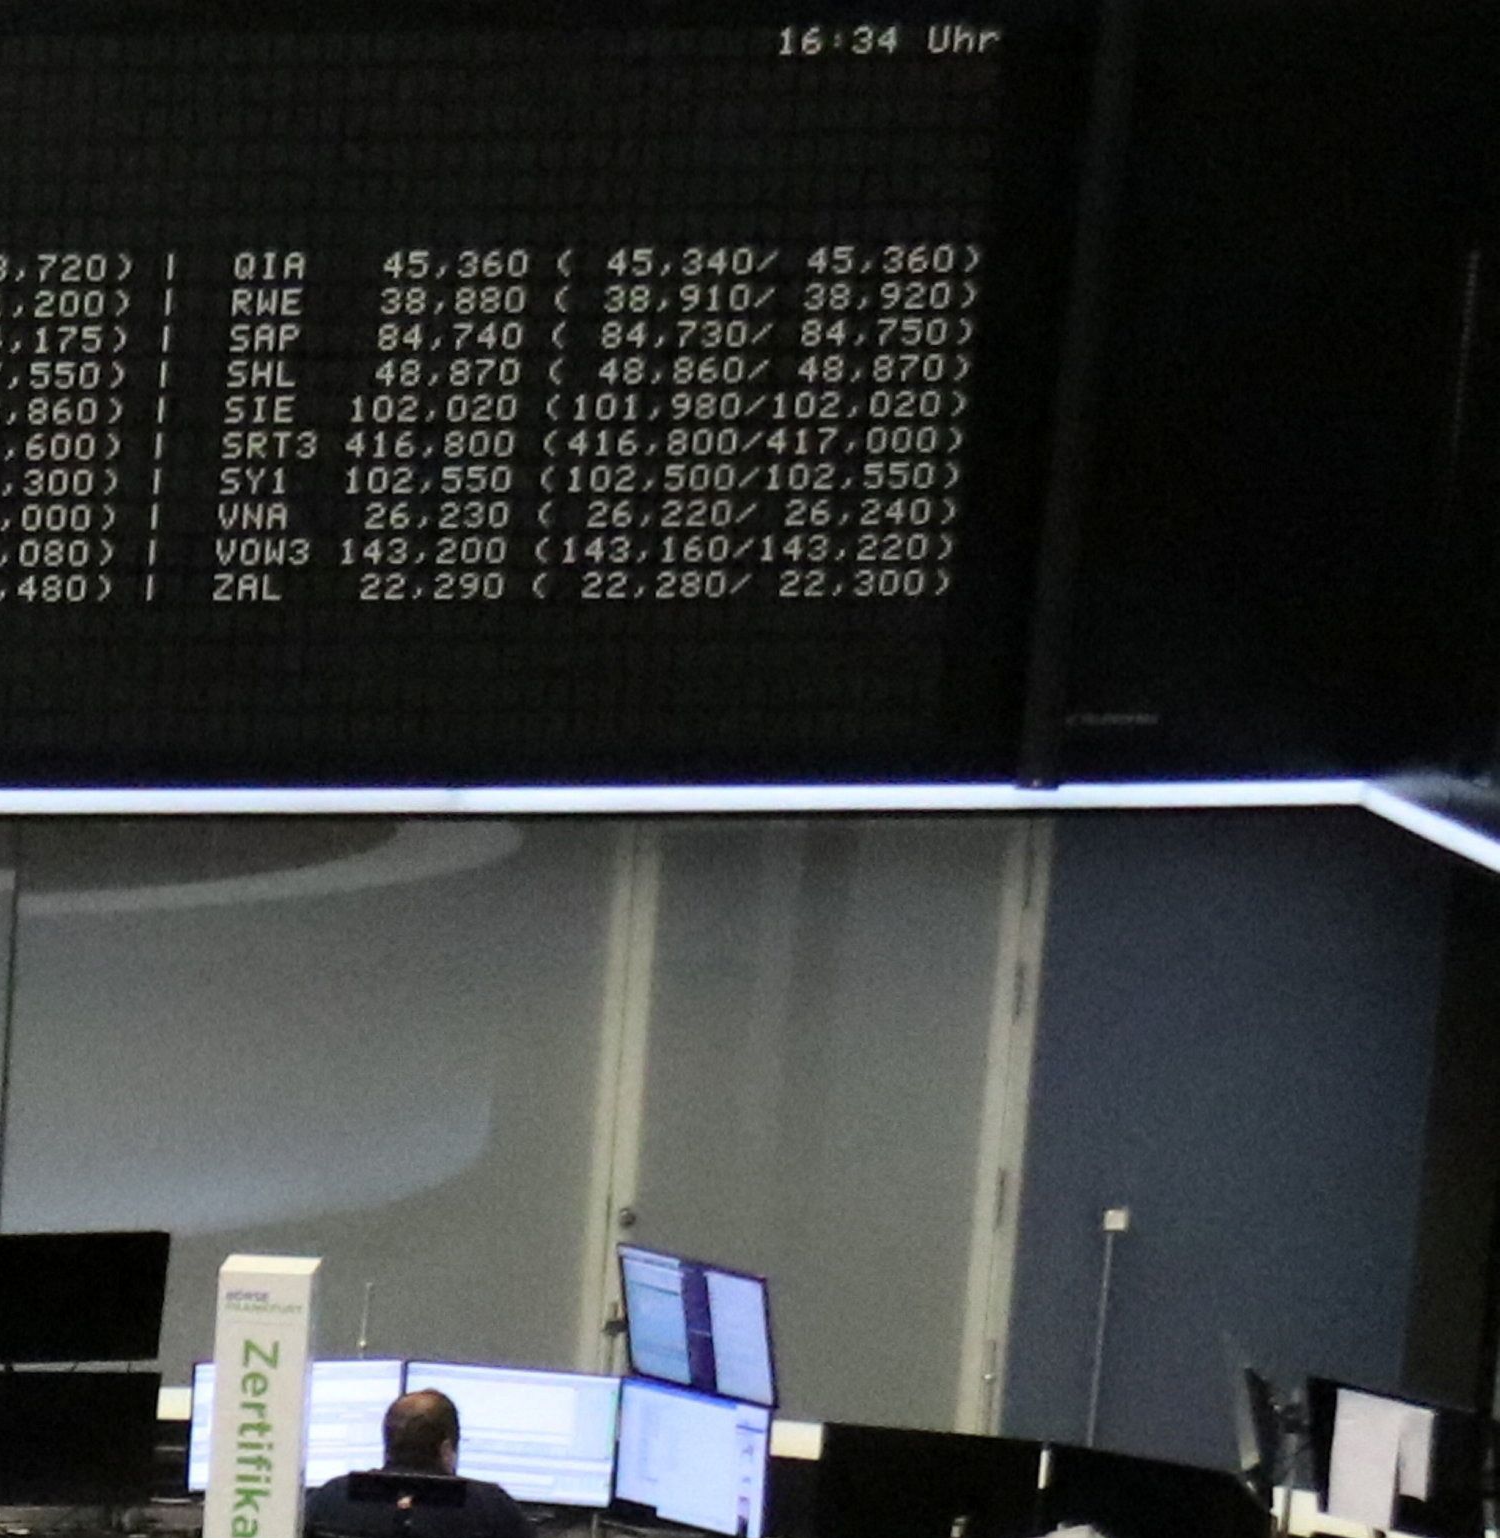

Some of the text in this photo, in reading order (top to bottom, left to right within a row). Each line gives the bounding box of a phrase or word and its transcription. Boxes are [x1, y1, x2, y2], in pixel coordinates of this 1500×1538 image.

[779, 24, 1000, 56] 16:34 Uhr
[234, 248, 529, 281] QIA 45,360
[231, 285, 526, 316] RWE 38,880
[229, 321, 524, 353] SAP 84,740
[226, 357, 521, 388] SHL 48,870
[224, 395, 295, 424] SIE
[350, 393, 518, 423] 102,020
[221, 430, 318, 460] SRT3
[345, 429, 515, 459] 416,800
[219, 466, 286, 496] SY1
[345, 464, 513, 495] 102,550
[217, 500, 510, 530] VNA 26,230
[215, 537, 310, 566] VOW3
[341, 536, 507, 565] 143,200
[212, 571, 505, 602] ZAL 22,290
